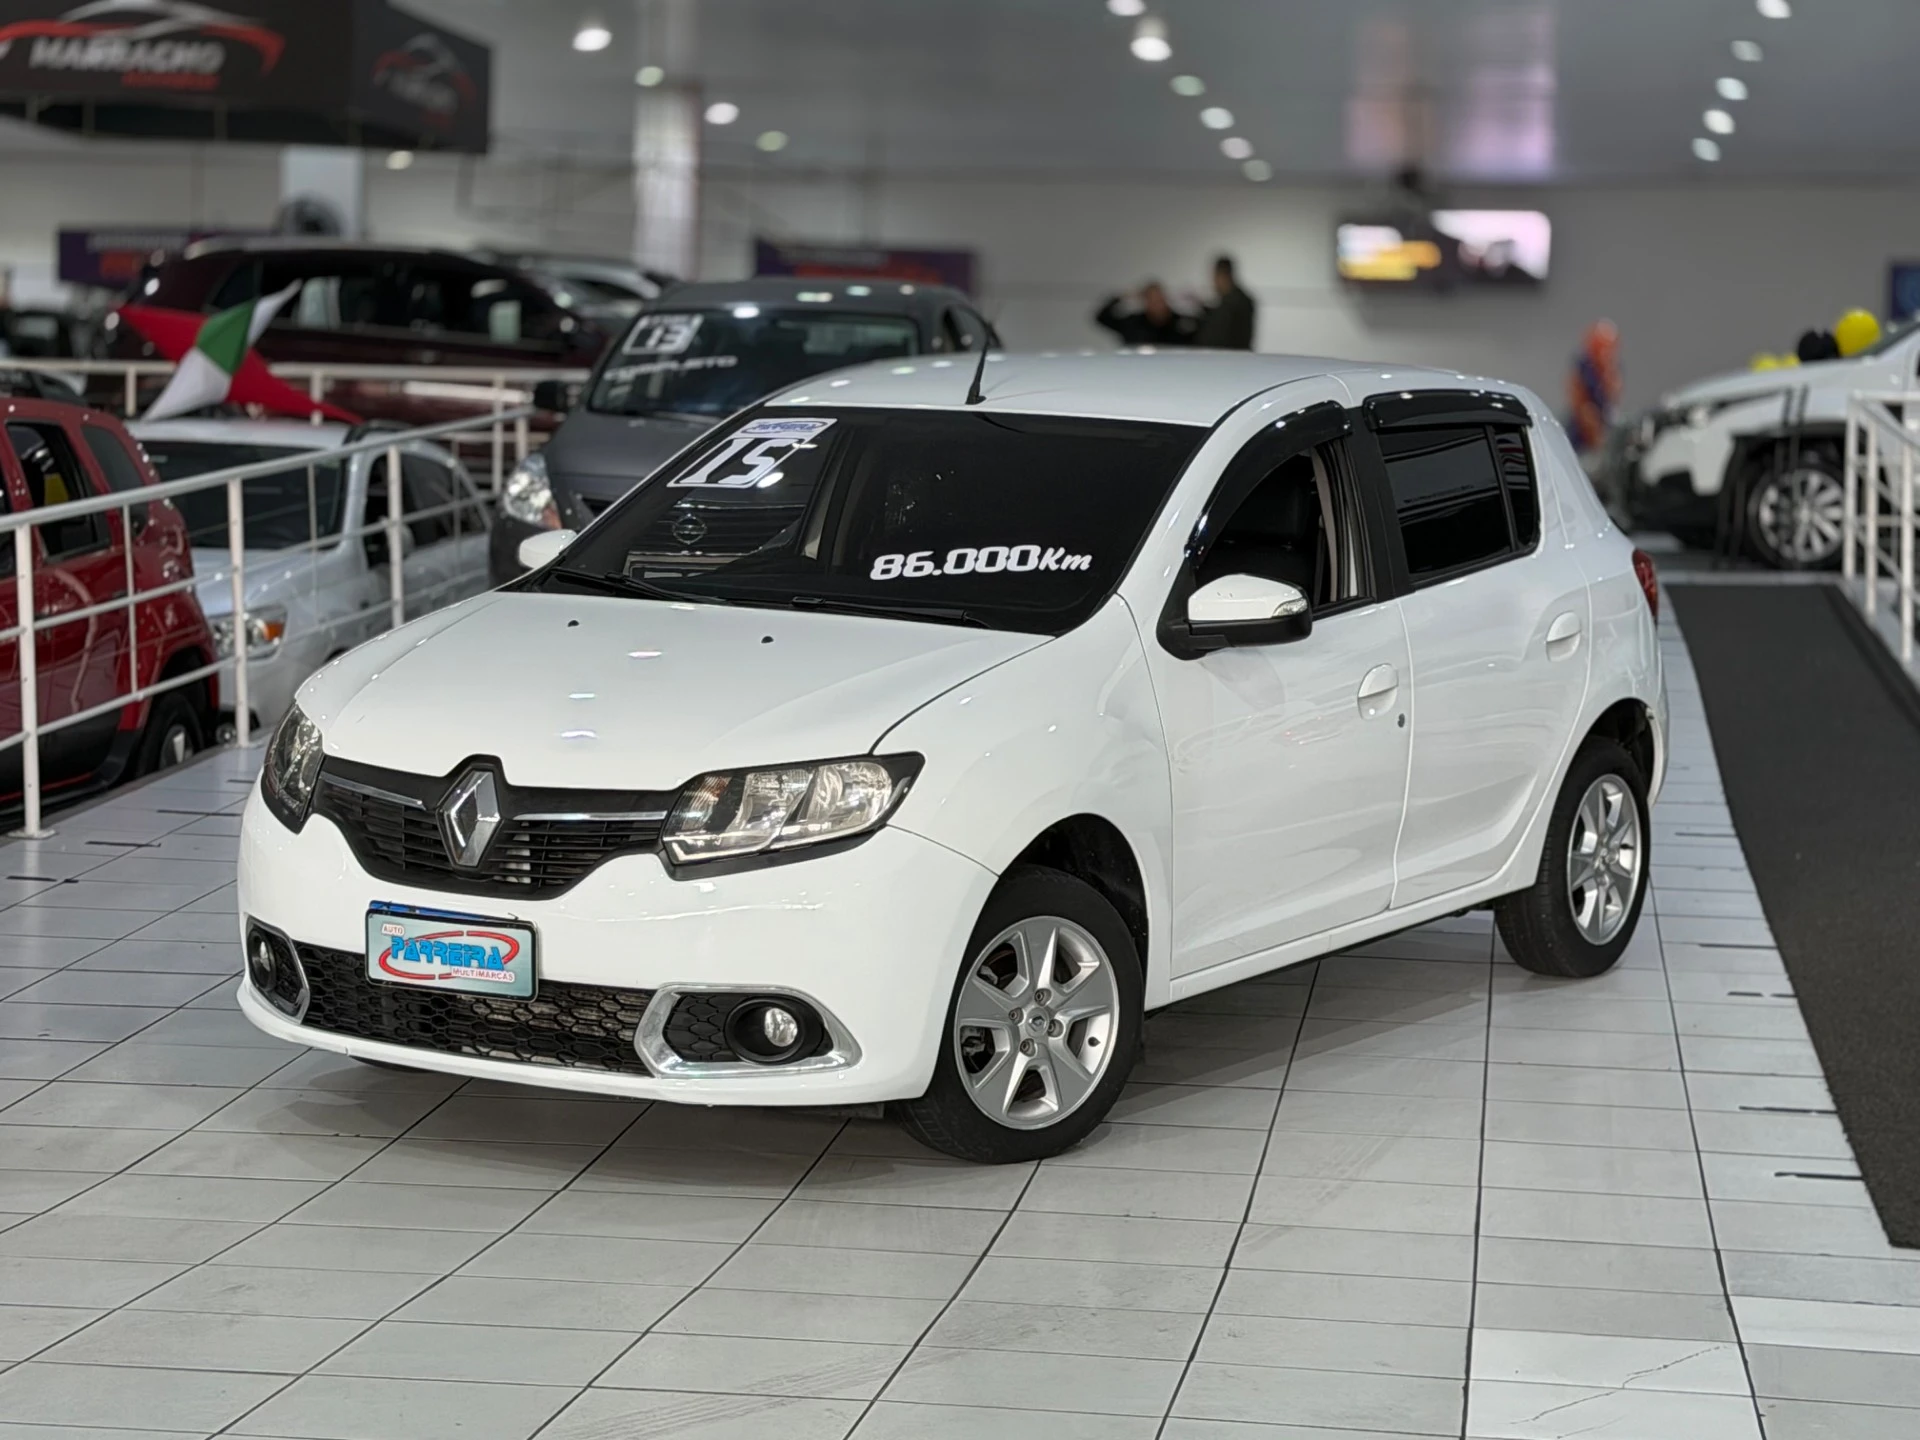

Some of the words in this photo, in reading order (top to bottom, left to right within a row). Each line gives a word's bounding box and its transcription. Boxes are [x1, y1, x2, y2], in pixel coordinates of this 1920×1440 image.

[679, 438, 799, 484] 15
[869, 544, 1093, 581] 86.000Km
[383, 924, 404, 935] AUTO
[391, 936, 505, 972] PARREIRA
[452, 968, 514, 982] MULTIMARCAS
